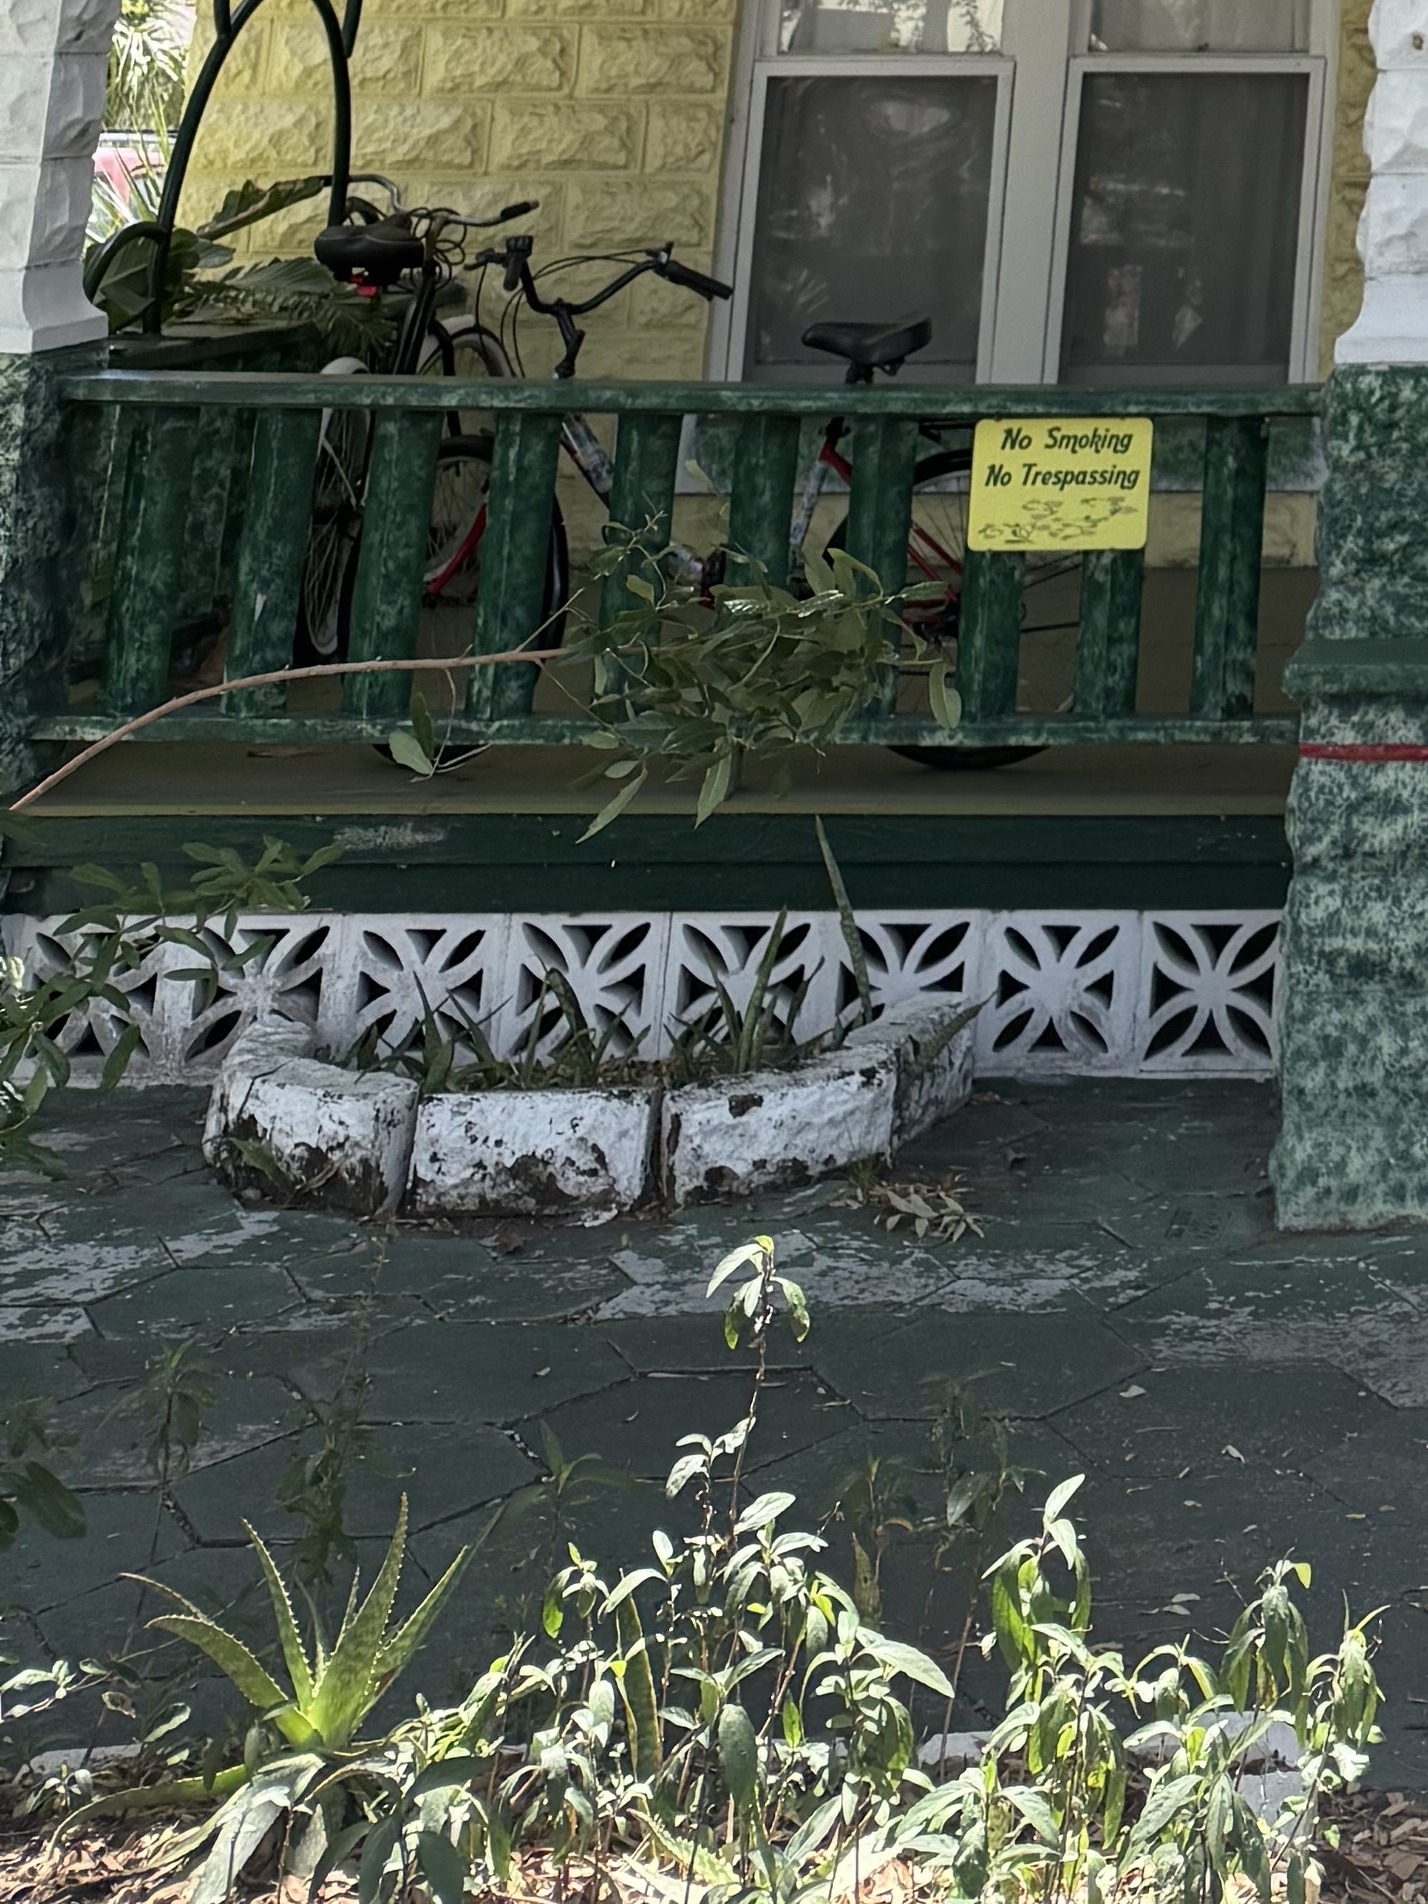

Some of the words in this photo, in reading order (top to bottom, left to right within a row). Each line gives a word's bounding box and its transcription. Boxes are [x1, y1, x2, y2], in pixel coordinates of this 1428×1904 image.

[1000, 427, 1032, 451] No
[1044, 427, 1133, 454] Smoking
[984, 463, 1012, 487] No
[1022, 463, 1140, 491] Trespassing
